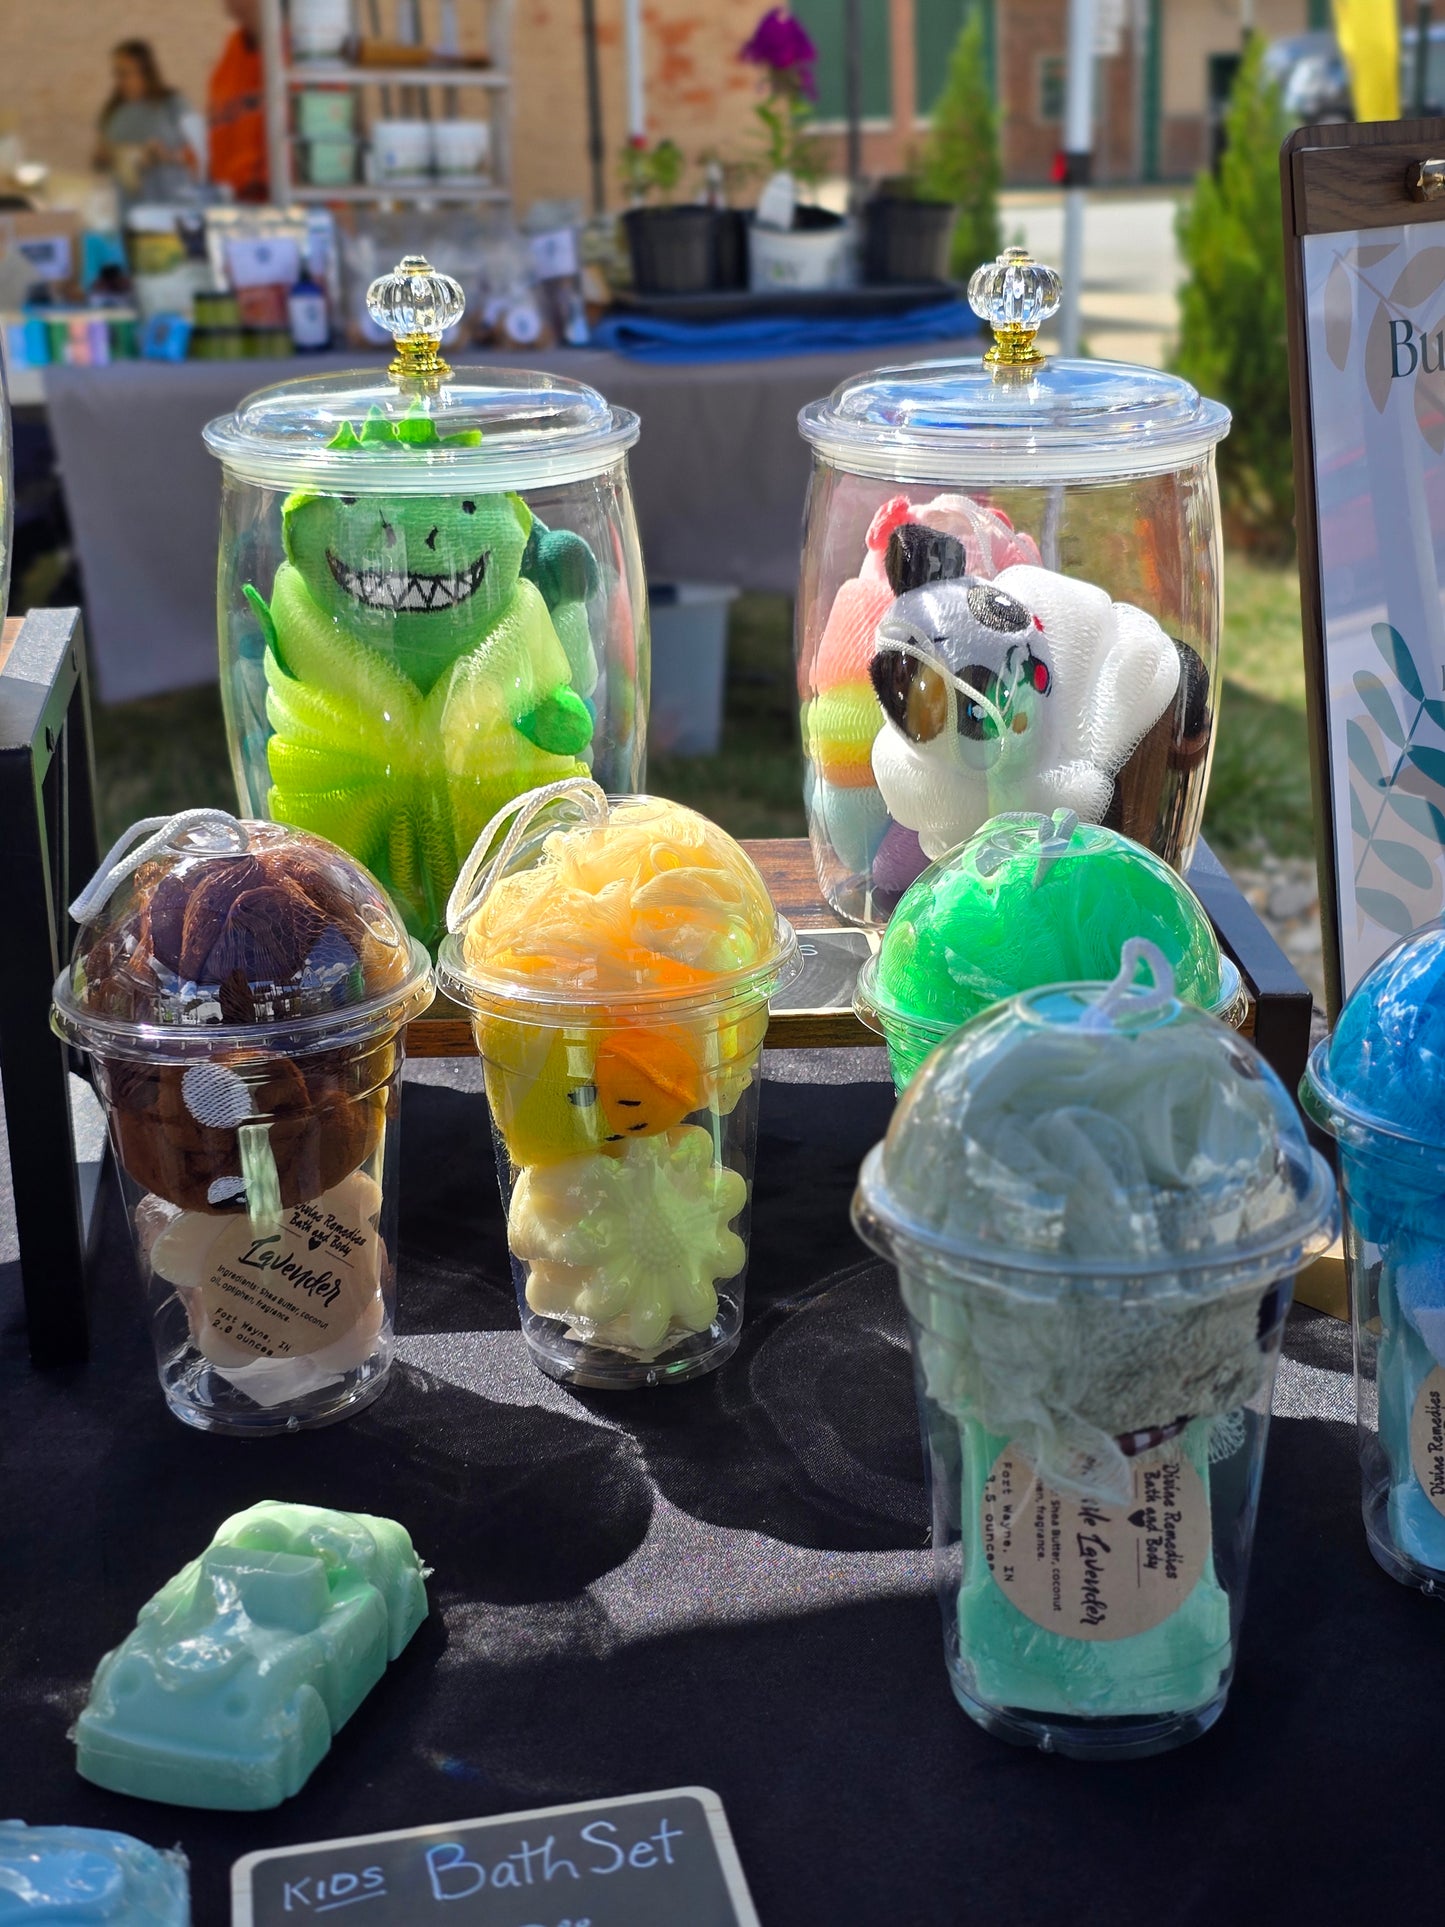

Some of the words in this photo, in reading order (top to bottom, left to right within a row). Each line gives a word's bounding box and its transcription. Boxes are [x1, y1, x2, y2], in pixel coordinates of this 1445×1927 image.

[289, 1211, 314, 1233] Bath
[311, 1229, 335, 1243] and
[329, 1235, 352, 1258] Body
[324, 1213, 367, 1247] Remedies
[238, 1234, 342, 1308] Lavender
[215, 1307, 238, 1323] Fort
[241, 1320, 272, 1343] Wayne,
[278, 1340, 292, 1352] IN
[255, 1299, 290, 1323] fragrance.
[260, 1288, 278, 1302] Shea
[277, 1297, 300, 1316] Butter,
[300, 1311, 329, 1330] coconut
[212, 1319, 233, 1334] 2.0
[236, 1333, 274, 1356] ounces
[1425, 1391, 1444, 1453] Remedies
[1002, 1462, 1013, 1495] Fort
[1143, 1470, 1161, 1503] Bath
[1162, 1463, 1181, 1507] Divine
[1428, 1455, 1445, 1496] Divine
[1000, 1504, 1013, 1553] Wayne,
[1034, 1505, 1047, 1562] fragrance.
[1051, 1500, 1061, 1526] Shea
[1144, 1507, 1163, 1534] and
[1051, 1528, 1062, 1565] Butter,
[1143, 1535, 1163, 1570] Body
[1164, 1510, 1184, 1579] Remedies
[1003, 1565, 1014, 1582] IN
[1052, 1567, 1062, 1612] coconut
[1077, 1532, 1112, 1626] Lavender
[283, 1865, 384, 1911] KIDS
[425, 1836, 579, 1901] Bath
[580, 1818, 684, 1874] Set
